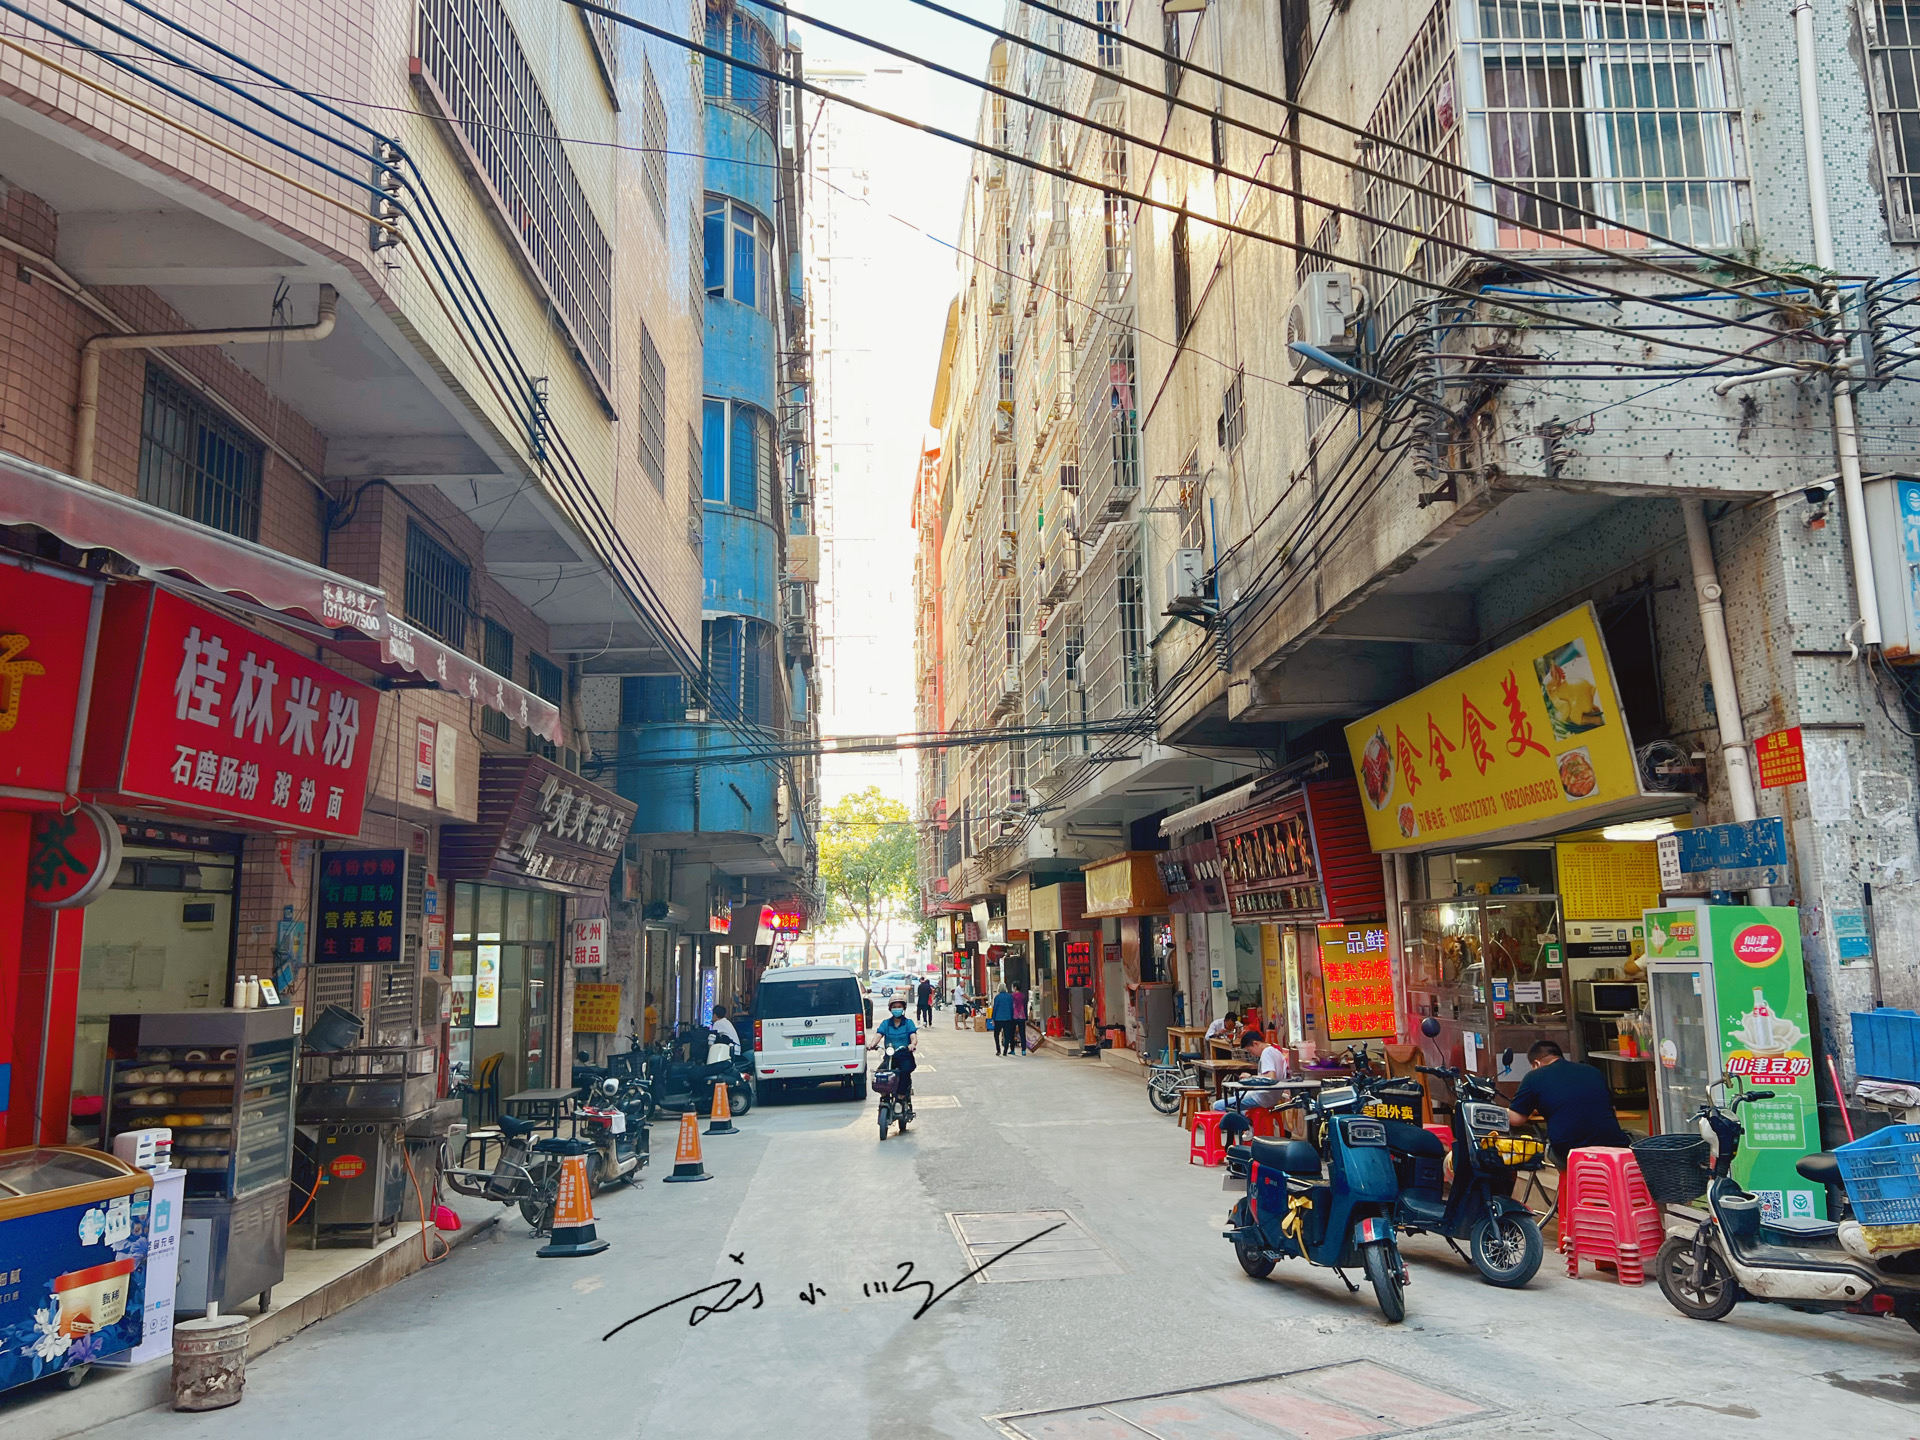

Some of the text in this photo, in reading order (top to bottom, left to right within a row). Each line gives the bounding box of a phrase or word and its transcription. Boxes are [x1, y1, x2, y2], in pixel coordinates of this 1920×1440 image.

[174, 626, 360, 769] 桂林米粉
[1395, 669, 1551, 797] 食全食美
[1767, 732, 1789, 749] 出租
[171, 745, 345, 821] 石磨肠粉 粥 粉 面
[1449, 795, 1498, 825] 13025127873
[1500, 778, 1559, 812] 18620686383
[326, 884, 394, 902] 石磨肠粉
[324, 910, 393, 929] 营养蒸饭
[575, 923, 602, 941] 化州
[1326, 929, 1386, 954] 一品鲜
[1744, 935, 1769, 946] 仙津
[575, 946, 601, 964] 甜品
[1331, 1010, 1395, 1034] 炒粉炒面
[1727, 1057, 1811, 1076] 仙津豆奶
[1363, 1103, 1414, 1120] 美团外卖
